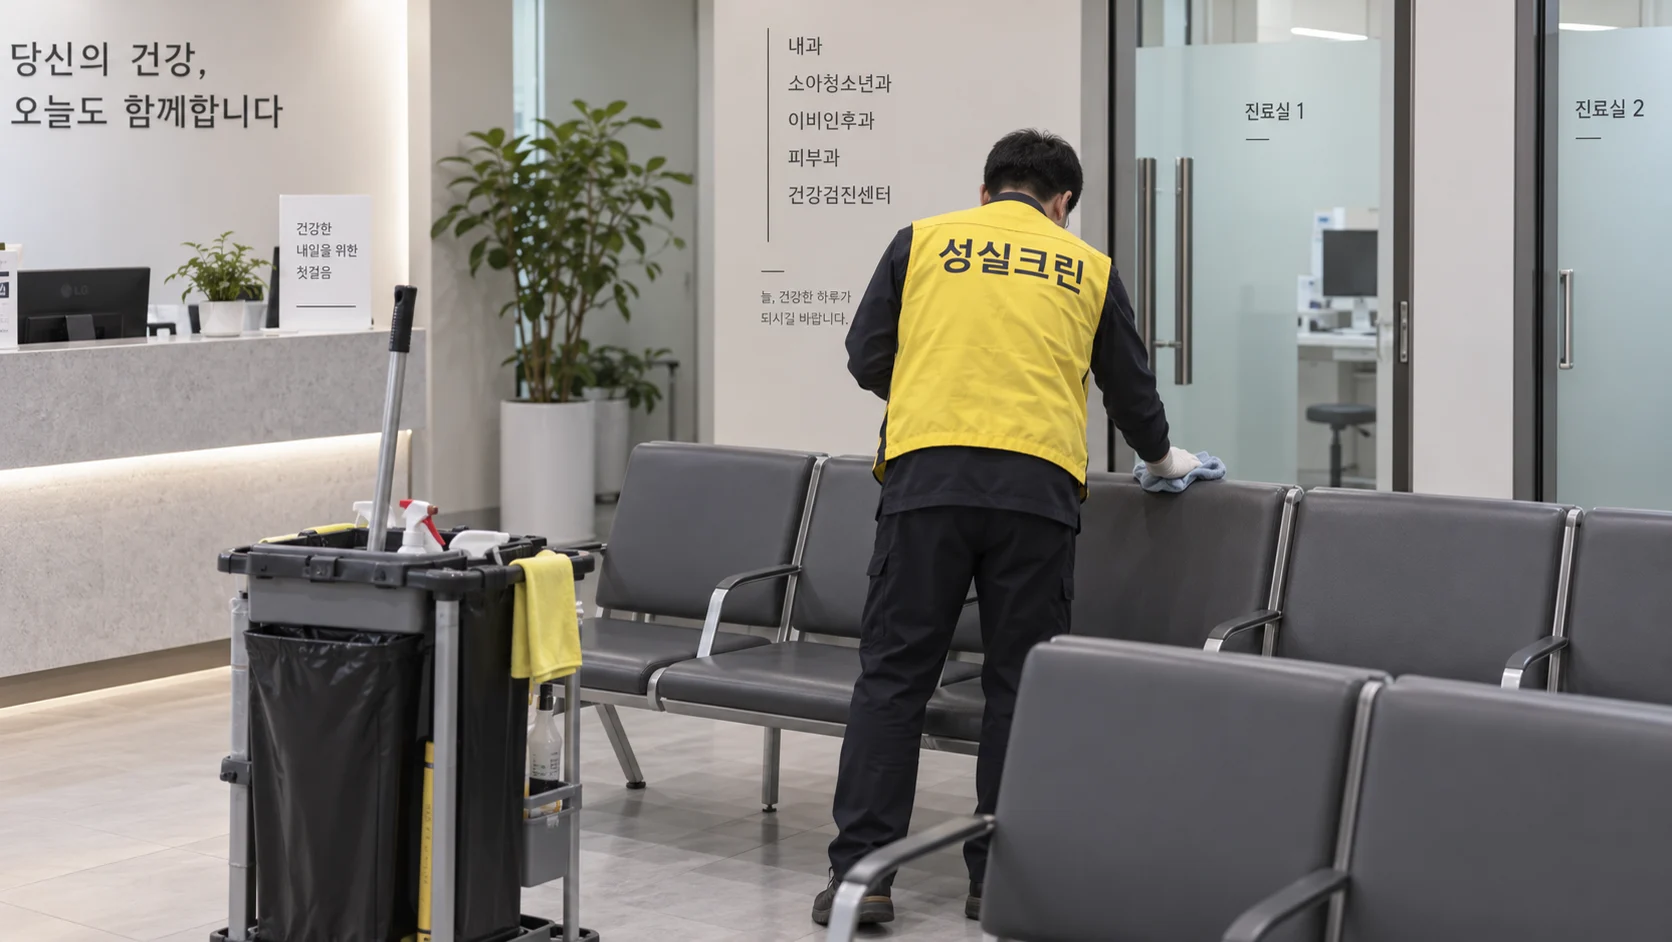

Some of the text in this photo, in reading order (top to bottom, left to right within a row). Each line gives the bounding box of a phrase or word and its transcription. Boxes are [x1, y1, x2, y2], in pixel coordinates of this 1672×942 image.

[788, 37, 823, 56] 내과
[11, 41, 206, 80] 당신의 건강,
[788, 74, 892, 94] 소아청소년과
[11, 94, 284, 129] 오늘도 함께합니다
[1245, 102, 1304, 121] 진료실 1
[1575, 99, 1645, 119] 진료실 2
[788, 111, 875, 131] 이비인후과
[788, 148, 841, 168] 피부과
[788, 186, 891, 205] 건강검진센터
[296, 221, 332, 236] 건강한
[296, 243, 358, 258] 내일을 위한
[296, 265, 332, 280] 첫걸음
[938, 238, 1085, 295] 성실크린
[761, 290, 852, 305] 늘, 건강한 하루가
[761, 312, 849, 326] 되시길 바랍니다.
